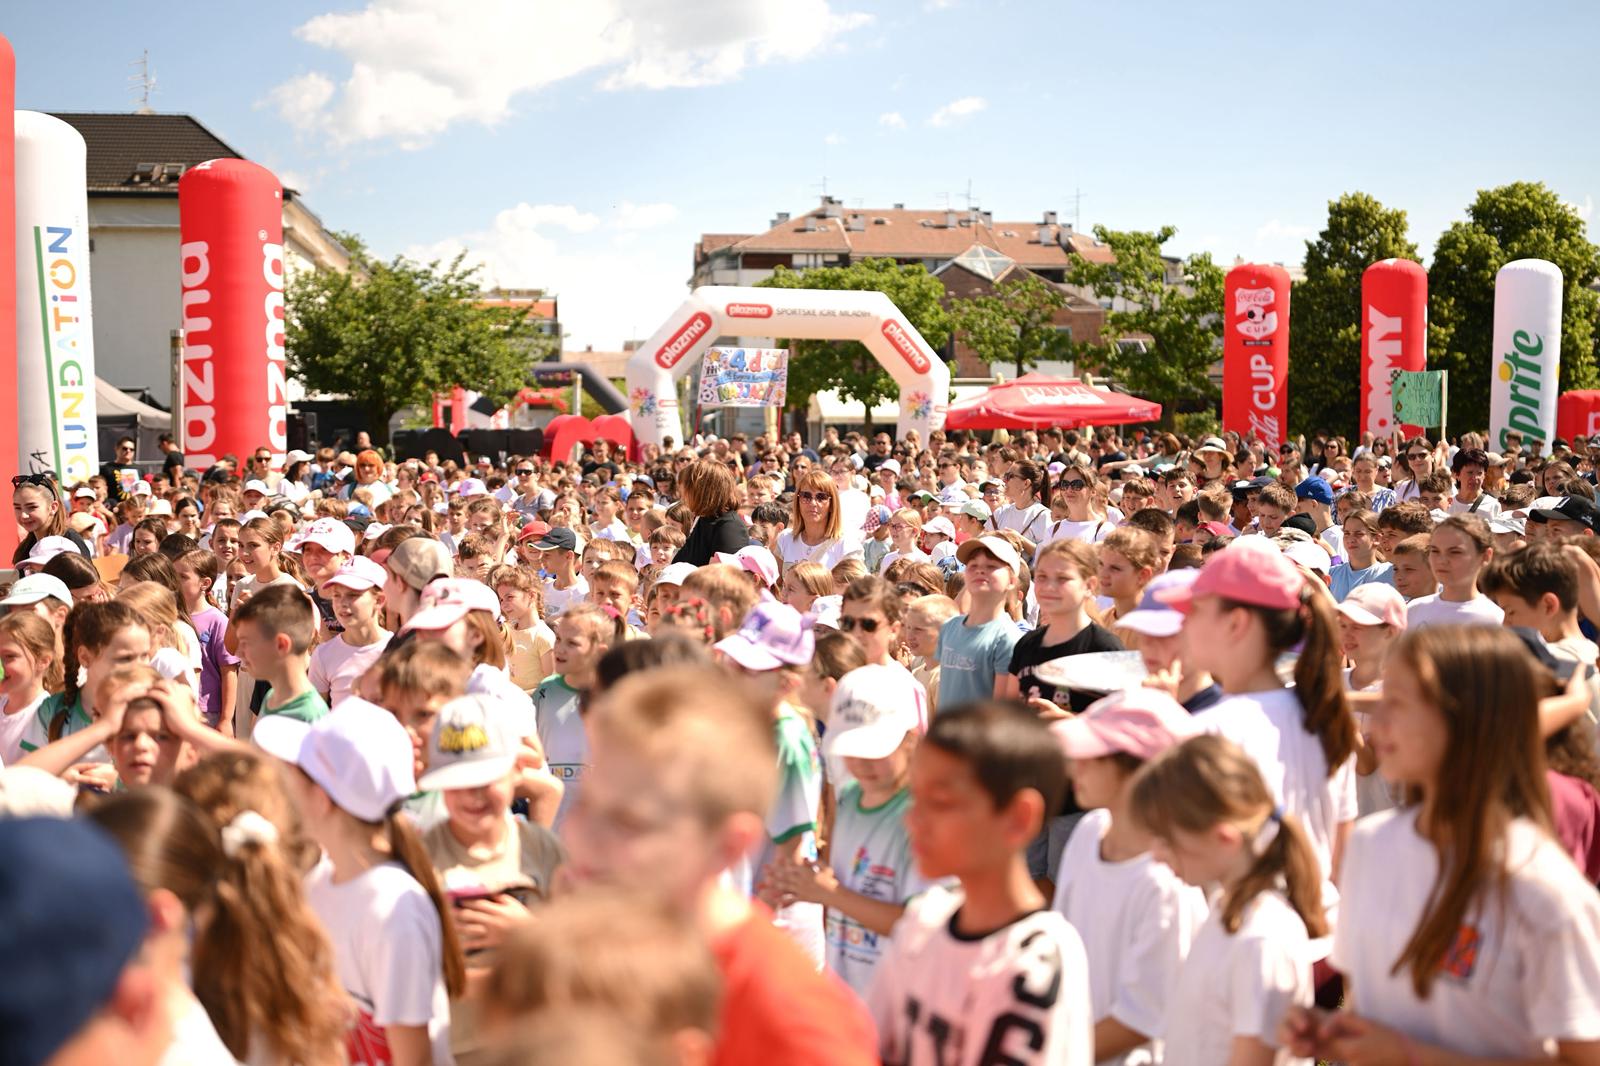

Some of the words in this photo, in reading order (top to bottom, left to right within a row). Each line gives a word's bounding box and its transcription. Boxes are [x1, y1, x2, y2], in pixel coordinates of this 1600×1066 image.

[729, 304, 768, 315] plazma
[776, 307, 817, 317] SPORTSKE
[660, 319, 706, 366] plazma
[884, 323, 926, 367] plazma
[1250, 354, 1276, 410] CUP
